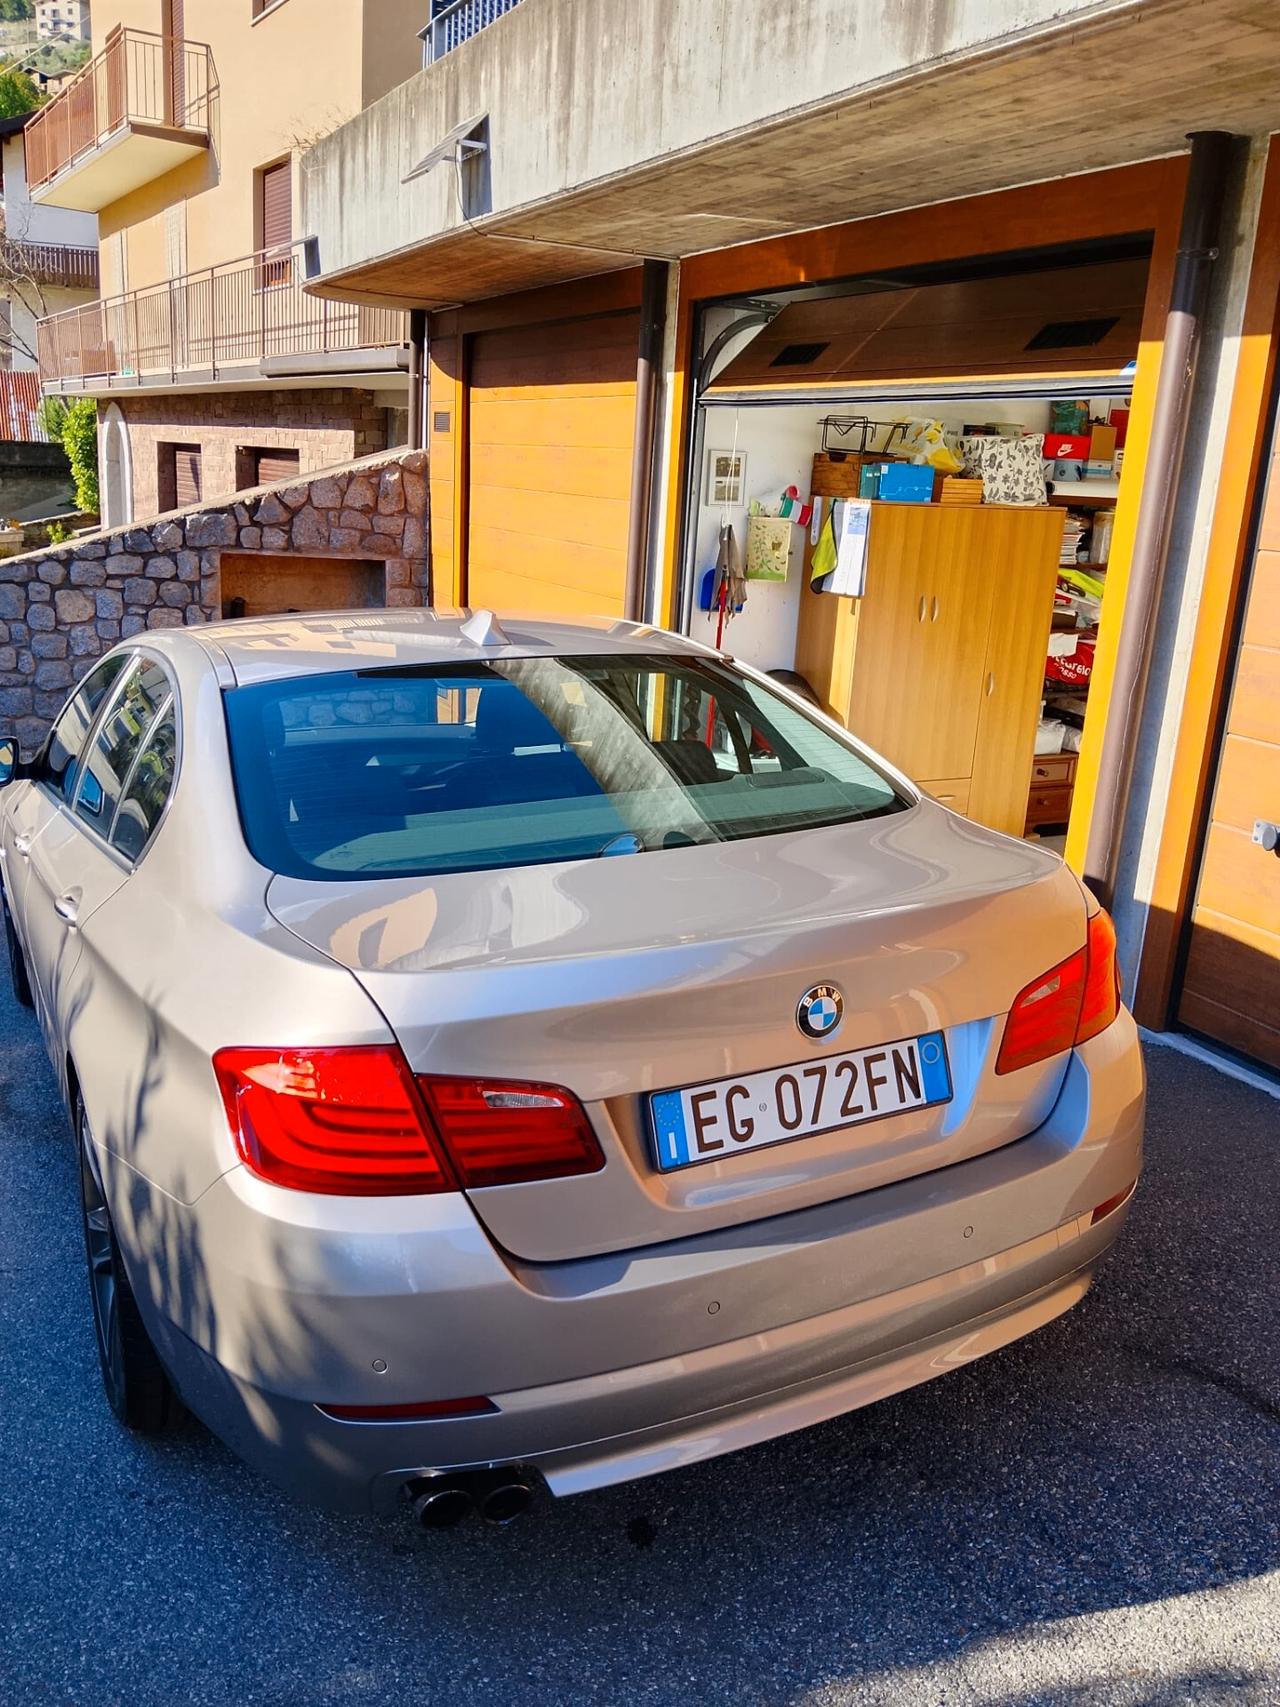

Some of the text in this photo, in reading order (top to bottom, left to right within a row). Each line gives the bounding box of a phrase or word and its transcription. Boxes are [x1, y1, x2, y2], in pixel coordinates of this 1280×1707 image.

[803, 987, 841, 1008] BMW
[690, 1045, 922, 1153] EG 072FN
[668, 1132, 677, 1159] I
